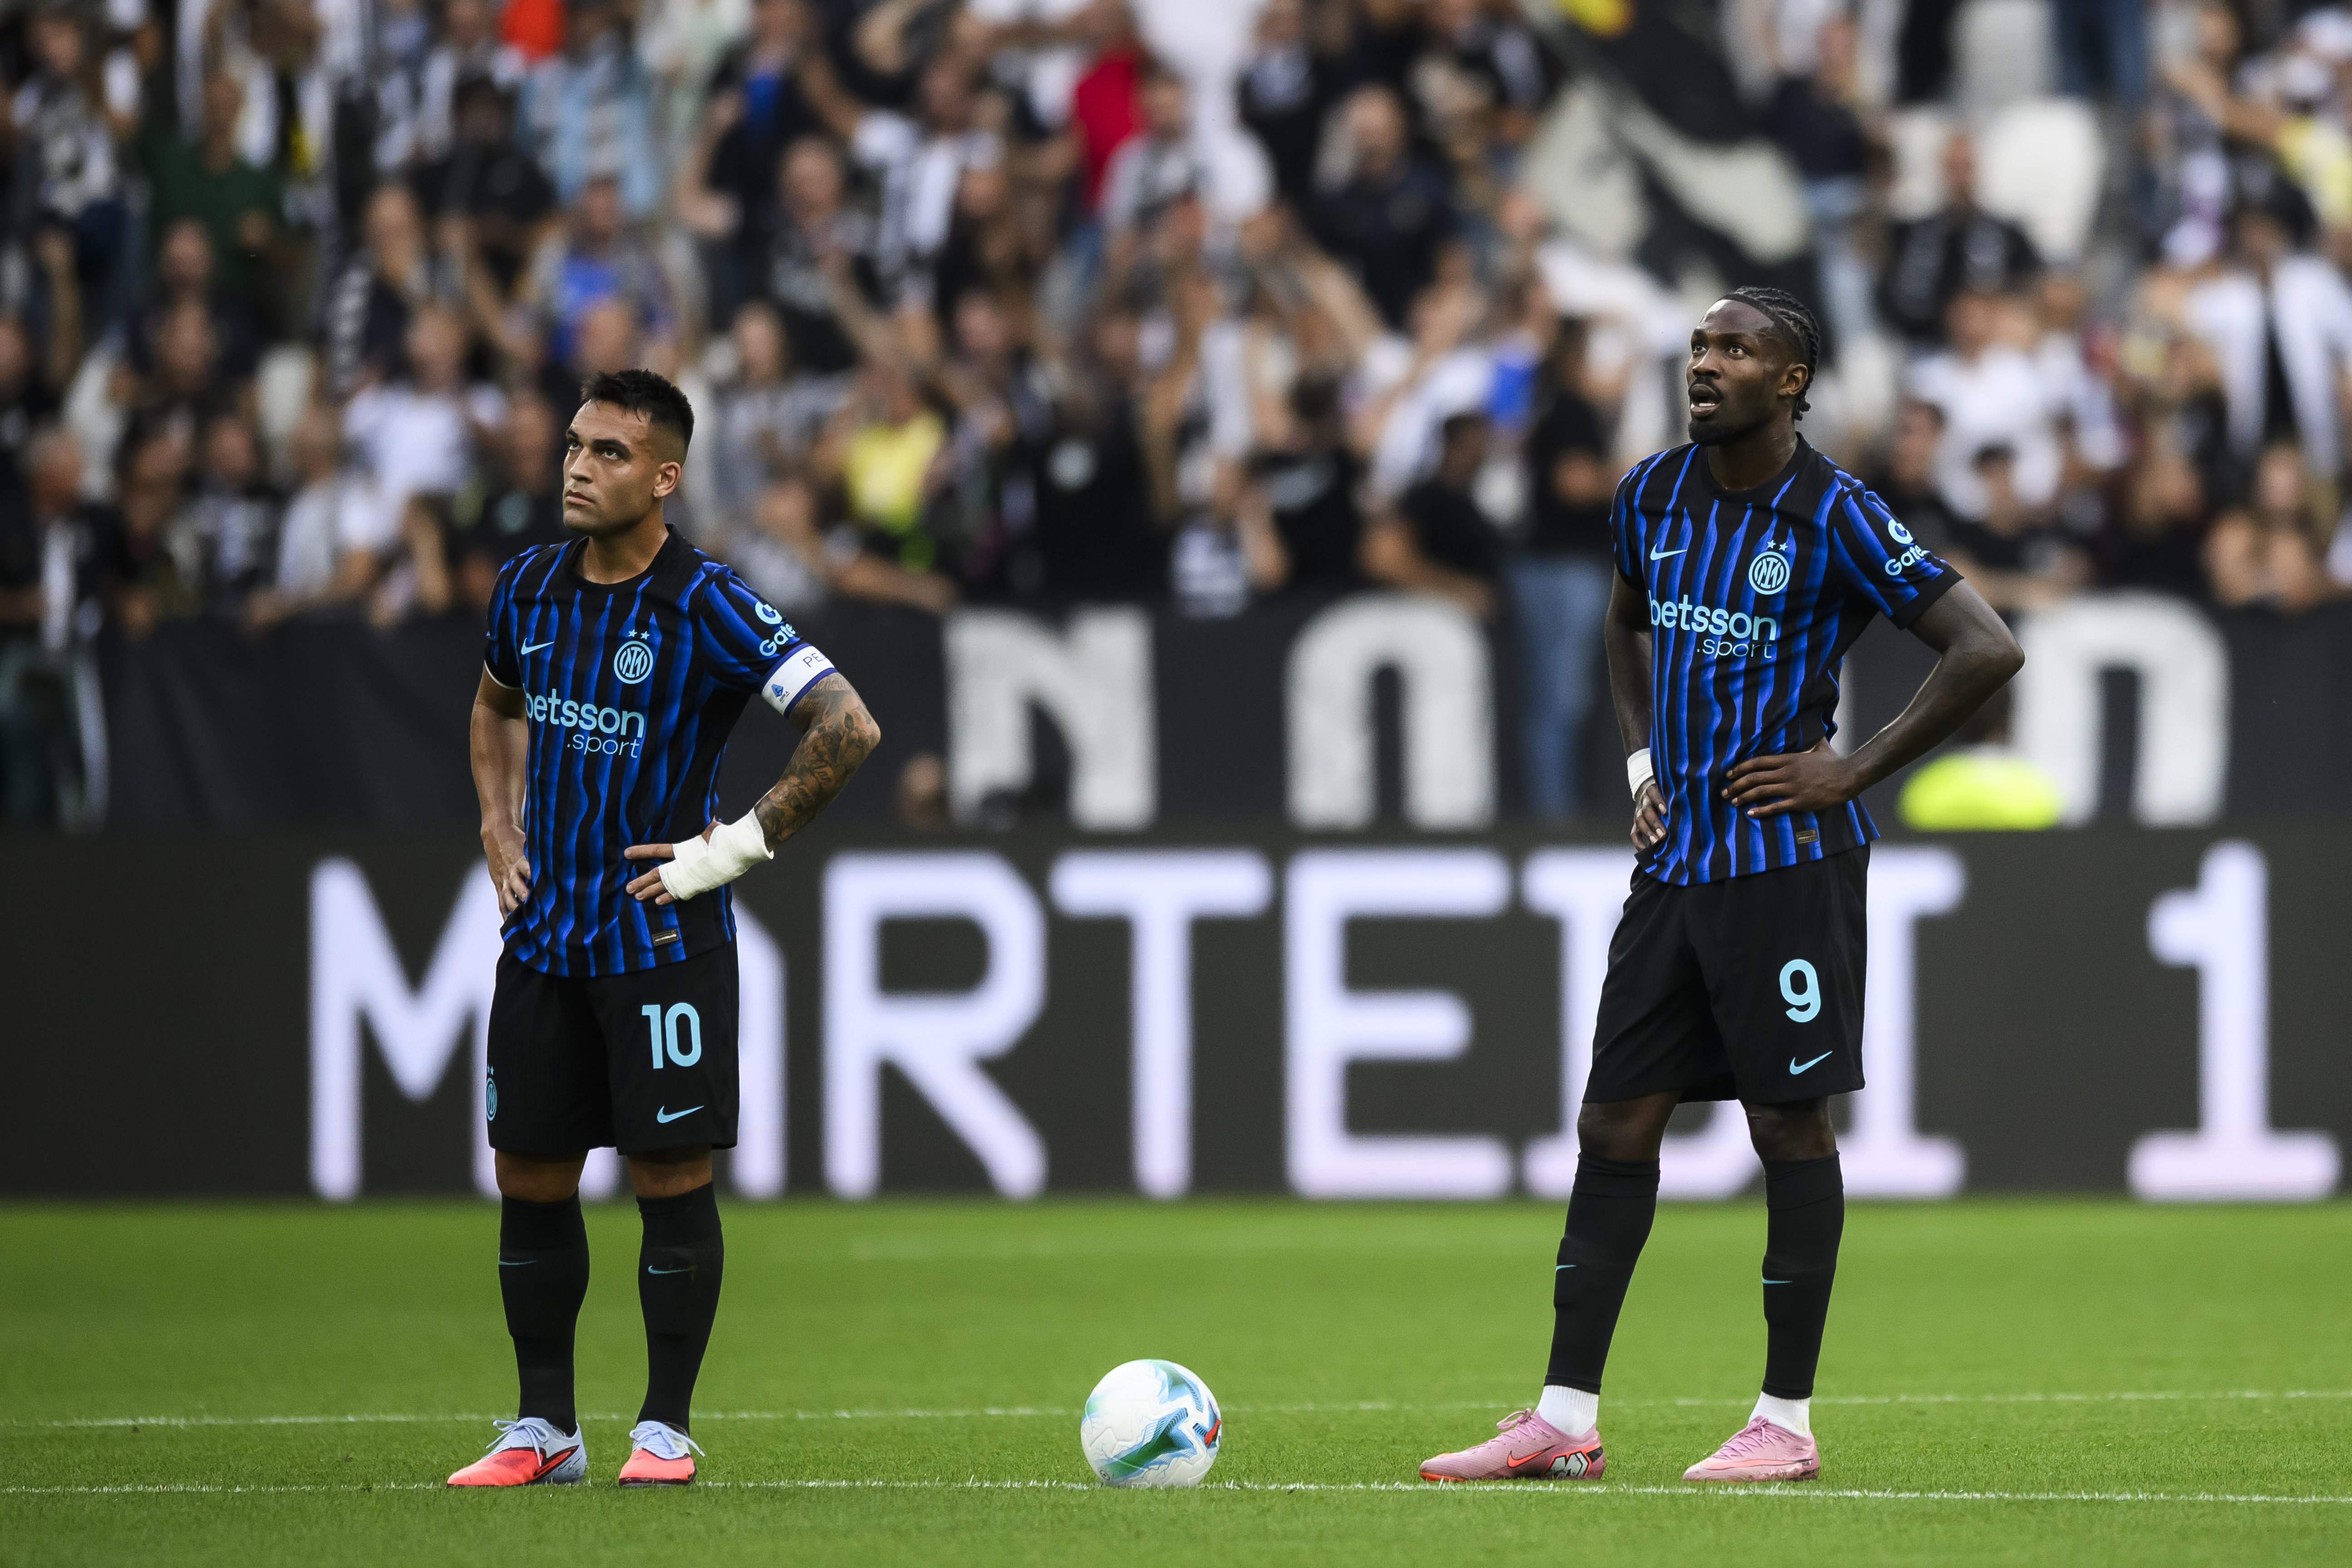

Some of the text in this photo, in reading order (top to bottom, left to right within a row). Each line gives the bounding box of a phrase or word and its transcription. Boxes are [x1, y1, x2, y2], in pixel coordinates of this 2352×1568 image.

[759, 624, 796, 656] Gate
[1648, 590, 1776, 640] betsson
[802, 653, 826, 668] PE
[1697, 639, 1772, 659] .sport
[523, 683, 644, 738] betsson
[567, 734, 640, 758] .sport
[1779, 959, 1821, 1022] 9
[642, 1003, 701, 1069] 10
[2126, 839, 2342, 1203] 1
